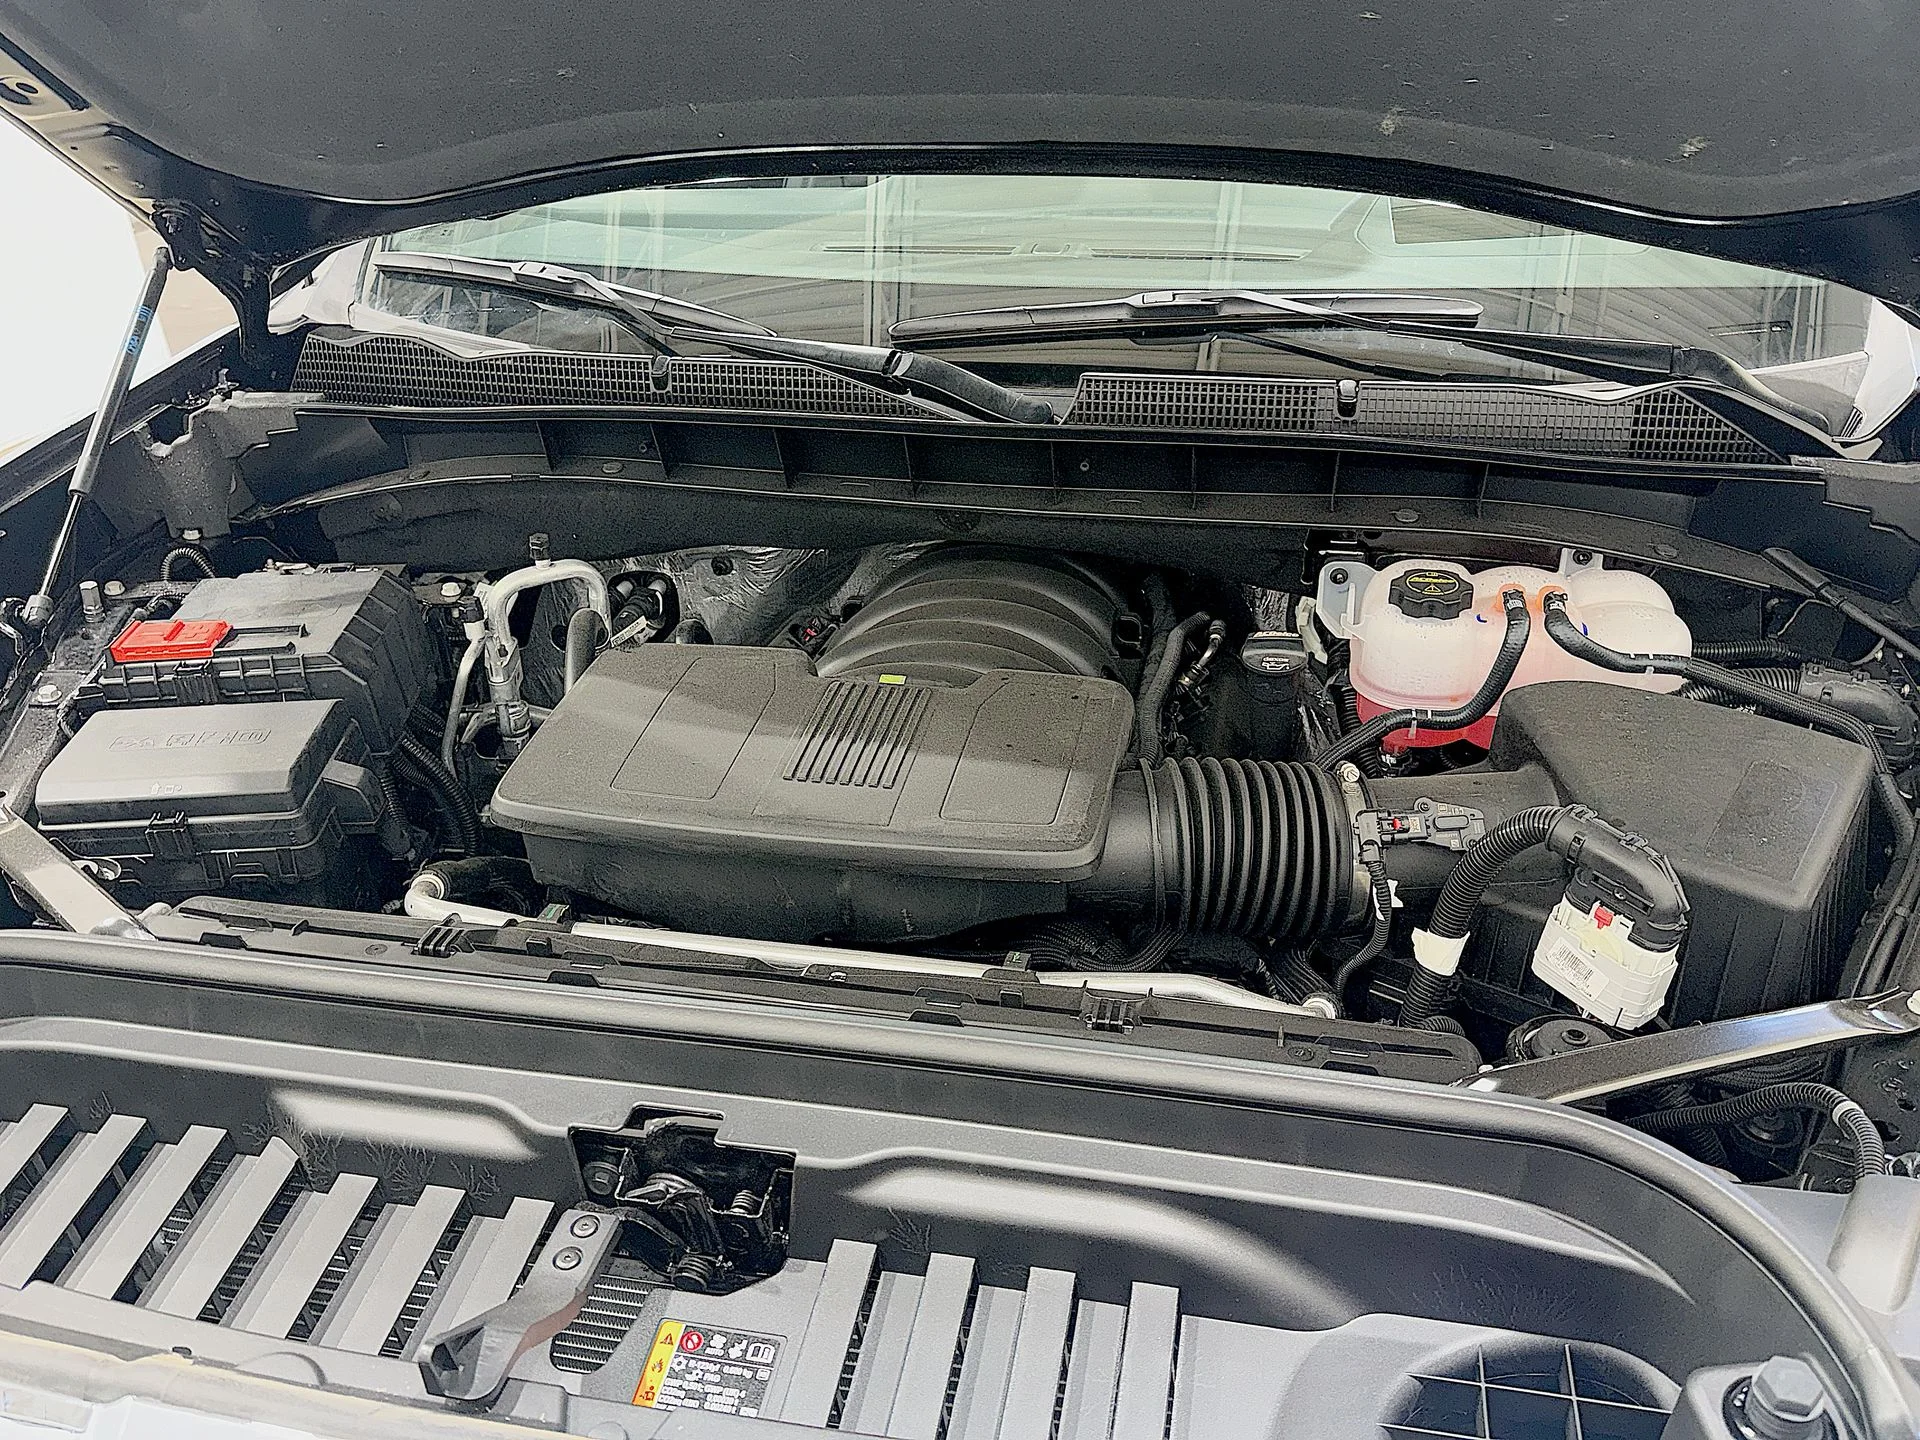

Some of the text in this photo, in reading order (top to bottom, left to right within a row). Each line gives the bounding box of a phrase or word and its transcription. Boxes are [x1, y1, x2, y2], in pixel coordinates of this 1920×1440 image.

[1252, 631, 1300, 639] ACDelco
[705, 1347, 724, 1356] AUTO
[703, 1373, 720, 1382] PAG
